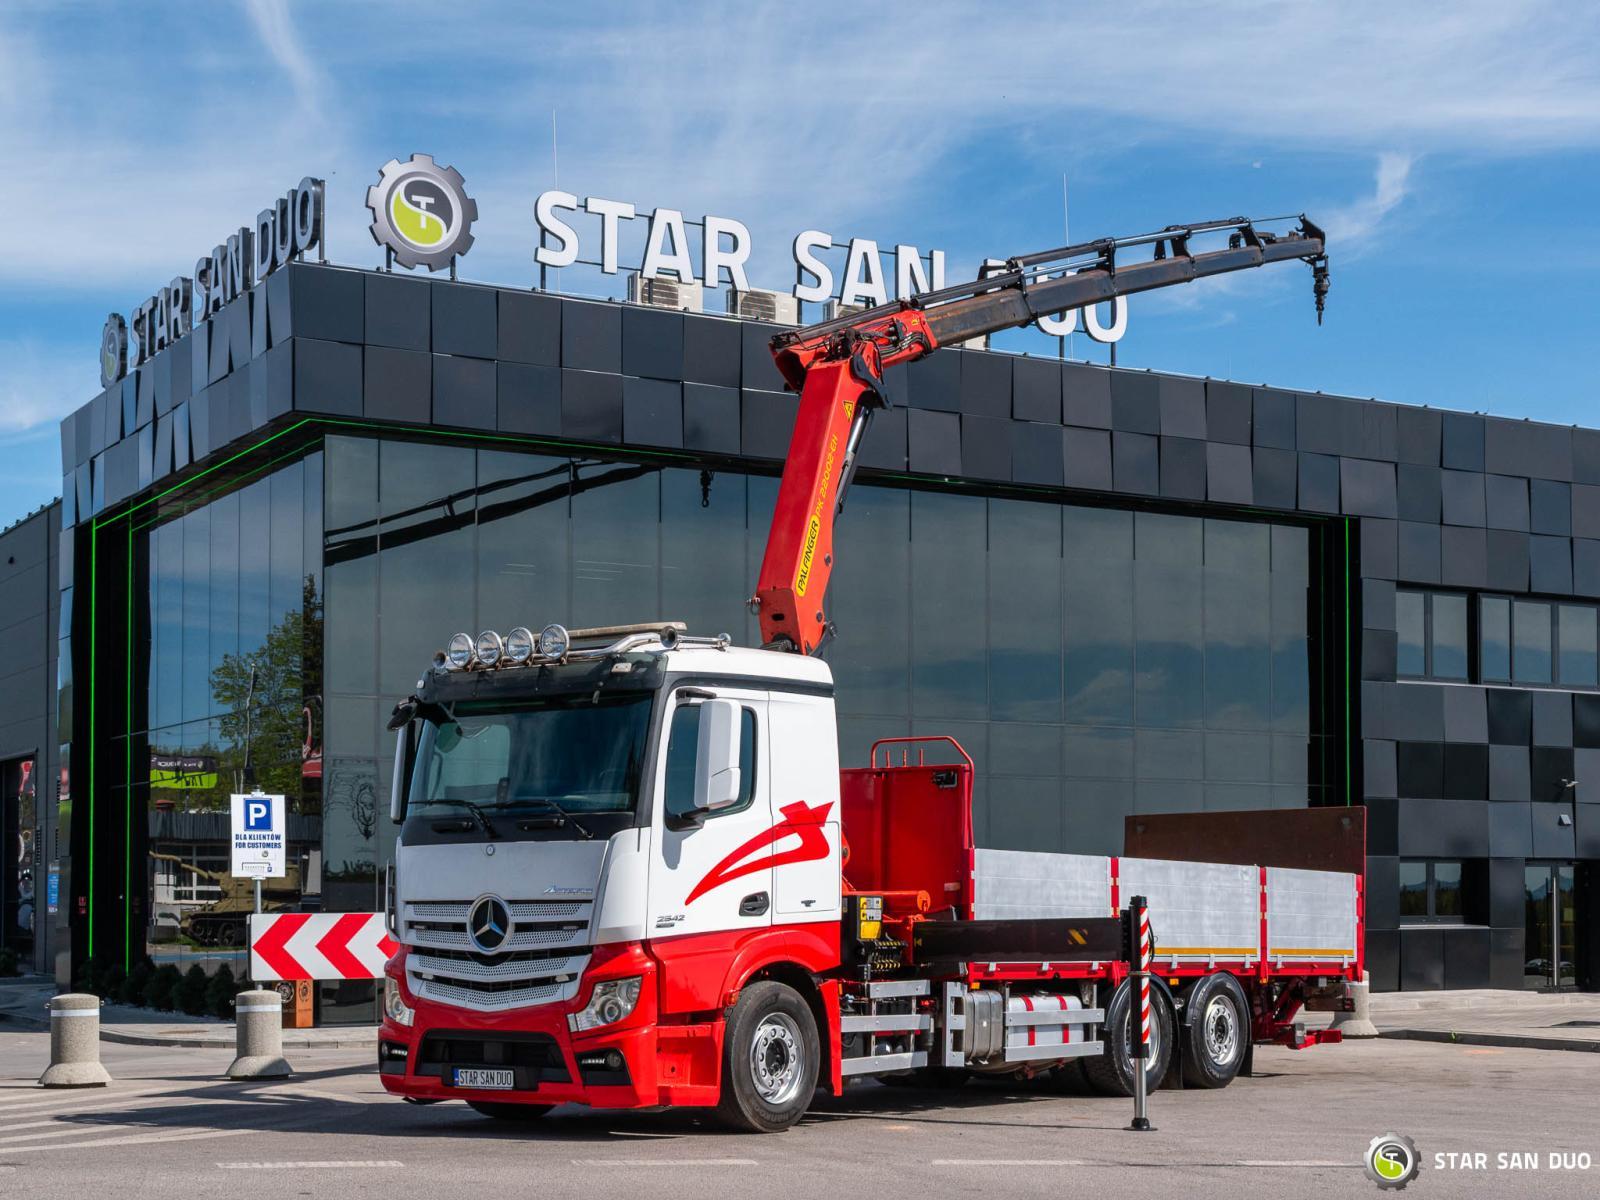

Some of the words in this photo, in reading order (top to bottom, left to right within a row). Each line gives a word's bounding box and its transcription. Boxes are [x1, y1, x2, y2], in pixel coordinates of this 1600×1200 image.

[130, 276, 193, 369] STAR
[194, 227, 251, 323] SAN
[256, 176, 322, 281] DUO
[534, 190, 751, 292] STAR
[793, 230, 946, 307] SAN
[797, 520, 819, 592] PALFINGER
[815, 498, 824, 518] PK
[235, 833, 247, 841] DLA
[249, 803, 267, 827] P
[459, 1070, 478, 1085] STAR
[480, 1071, 495, 1085] SAN
[496, 1071, 512, 1086] DUO
